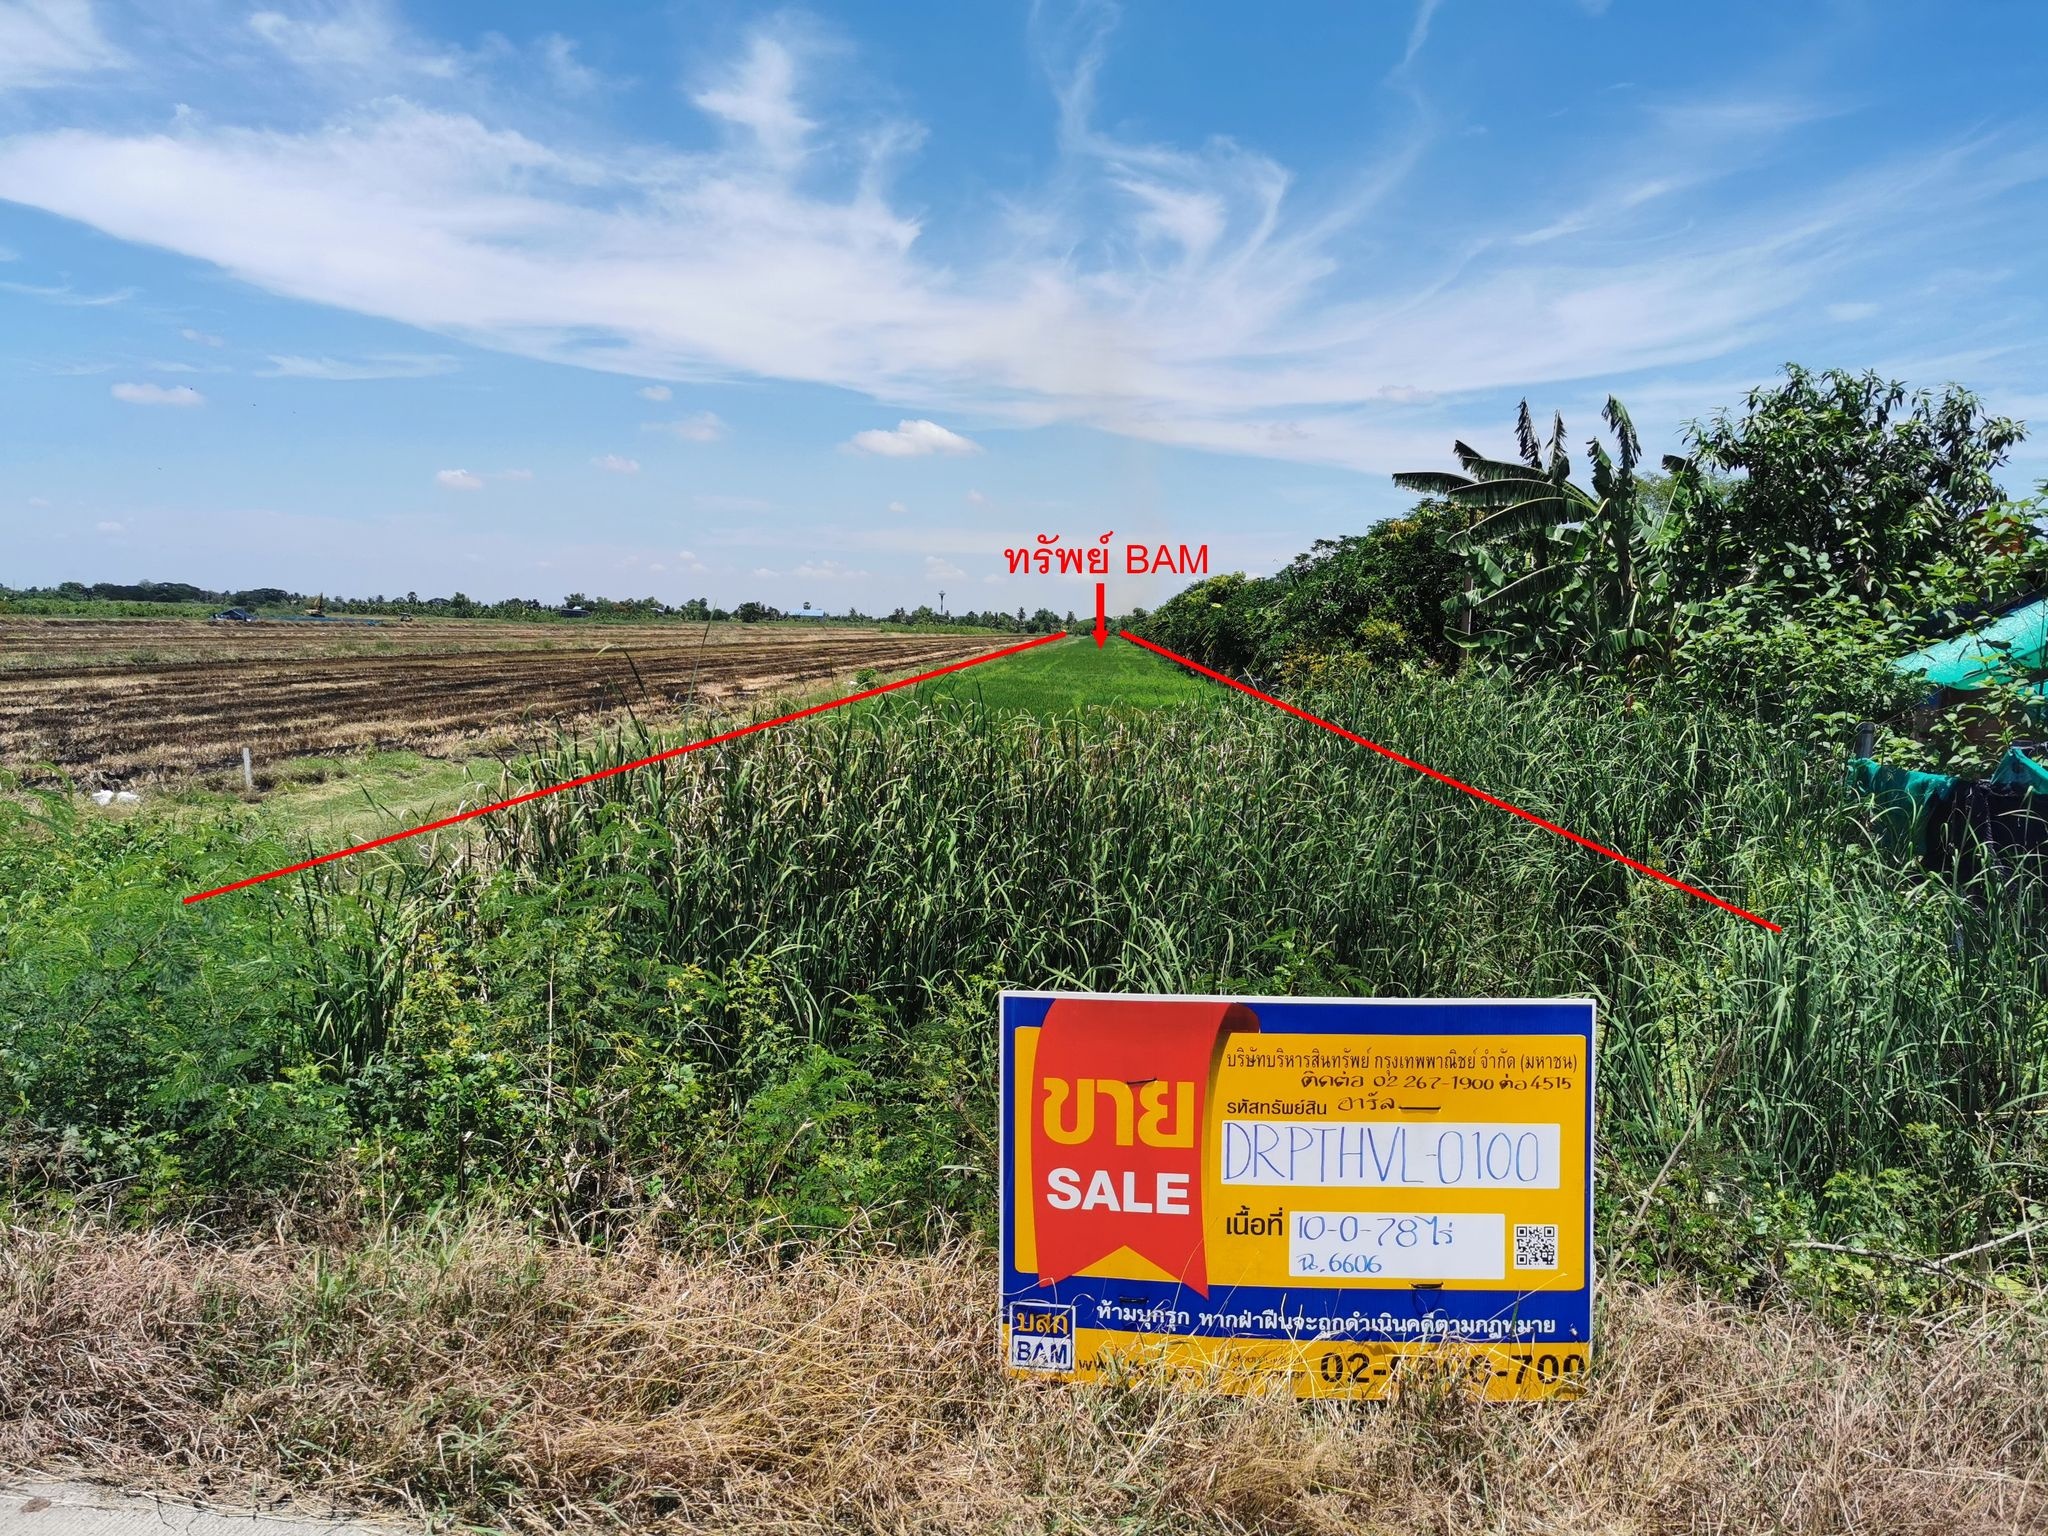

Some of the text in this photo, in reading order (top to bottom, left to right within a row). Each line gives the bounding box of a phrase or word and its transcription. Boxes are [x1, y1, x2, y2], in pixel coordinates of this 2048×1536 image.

[1226, 1047, 1578, 1076] บริษัทบริหารสินทรัพย์ กรุงเทพพาณิชย์ จำกัด (มหาชน)
[1301, 1070, 1364, 1088] ติดต่อ
[1373, 1075, 1398, 1088] 02
[1530, 1076, 1573, 1090] 4515
[1042, 1076, 1195, 1149] ขาย
[1226, 1098, 1328, 1116] รหัสทรัพย์สิน
[1223, 1122, 1539, 1185] DRPTHVL-0100
[1046, 1167, 1190, 1215] SALE
[1225, 1205, 1284, 1237] เนื้อที่
[1017, 1312, 1068, 1335] บสก
[1095, 1299, 1190, 1331] ห้ามบุกรุก
[1016, 1340, 1068, 1365] BAM
